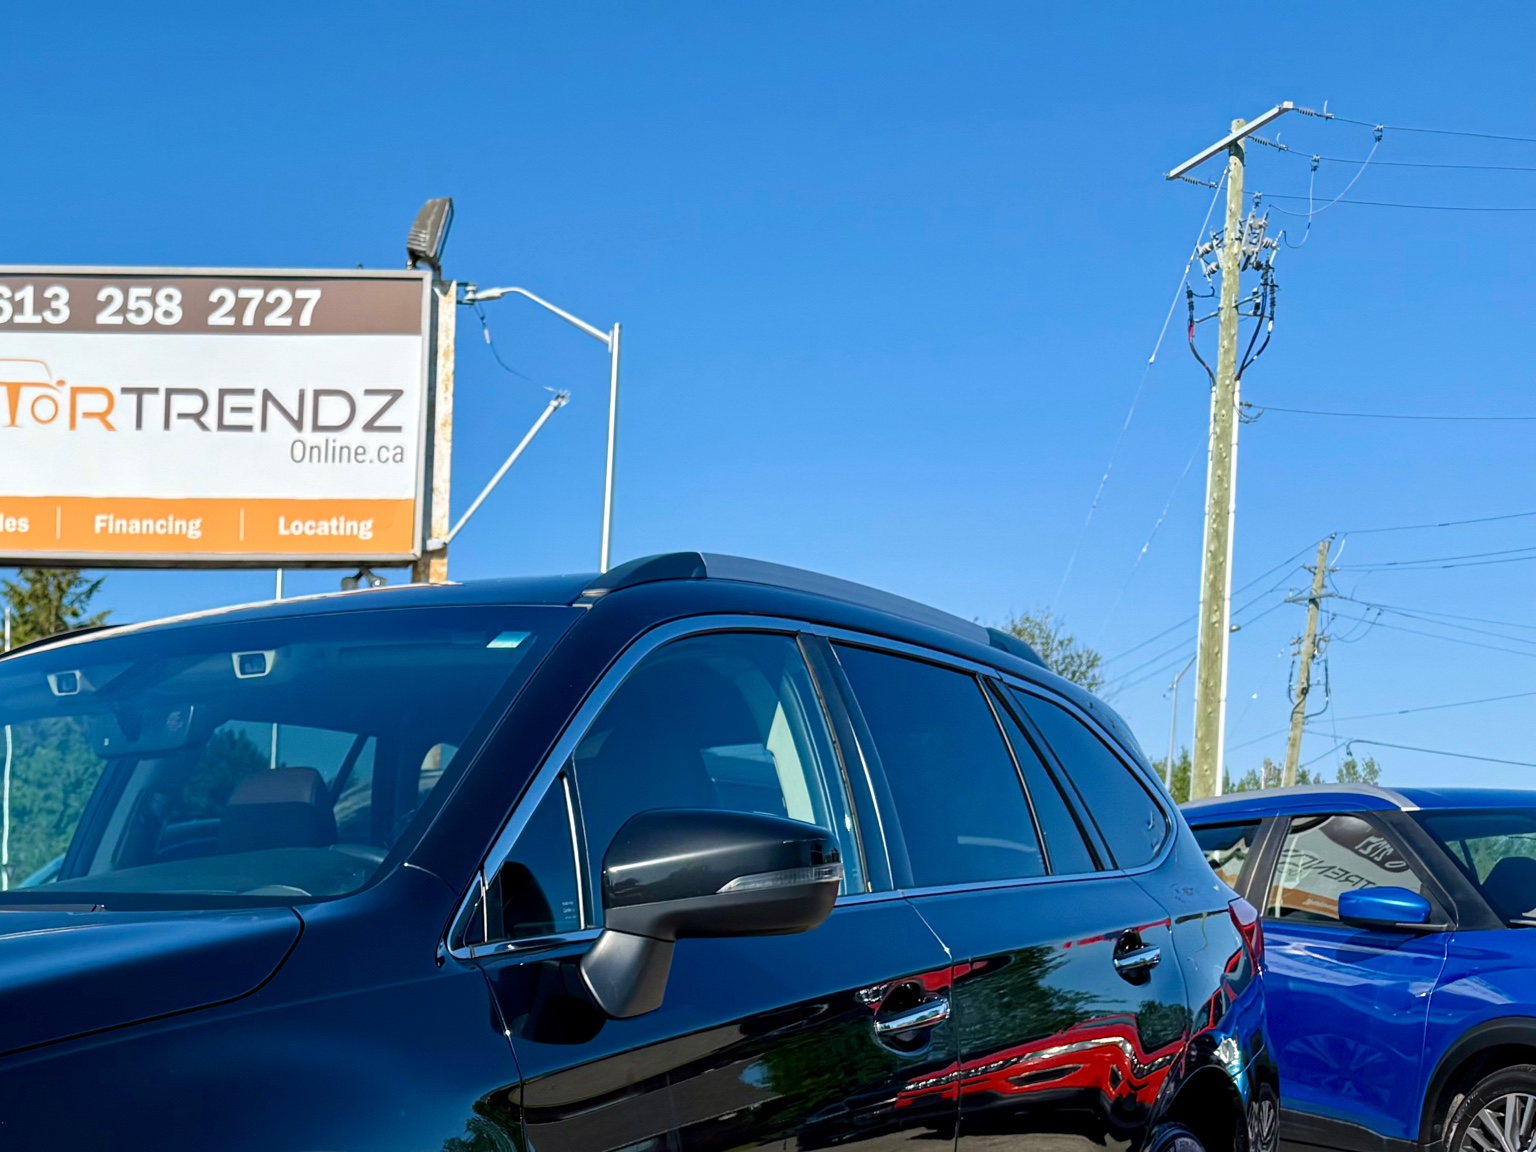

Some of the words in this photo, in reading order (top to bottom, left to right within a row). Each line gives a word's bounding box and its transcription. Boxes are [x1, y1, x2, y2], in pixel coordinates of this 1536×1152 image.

[95, 286, 183, 326] 258
[207, 287, 322, 327] 2727
[290, 438, 405, 465] Online.ca
[94, 514, 202, 540] Financing
[278, 515, 374, 540] Locating
